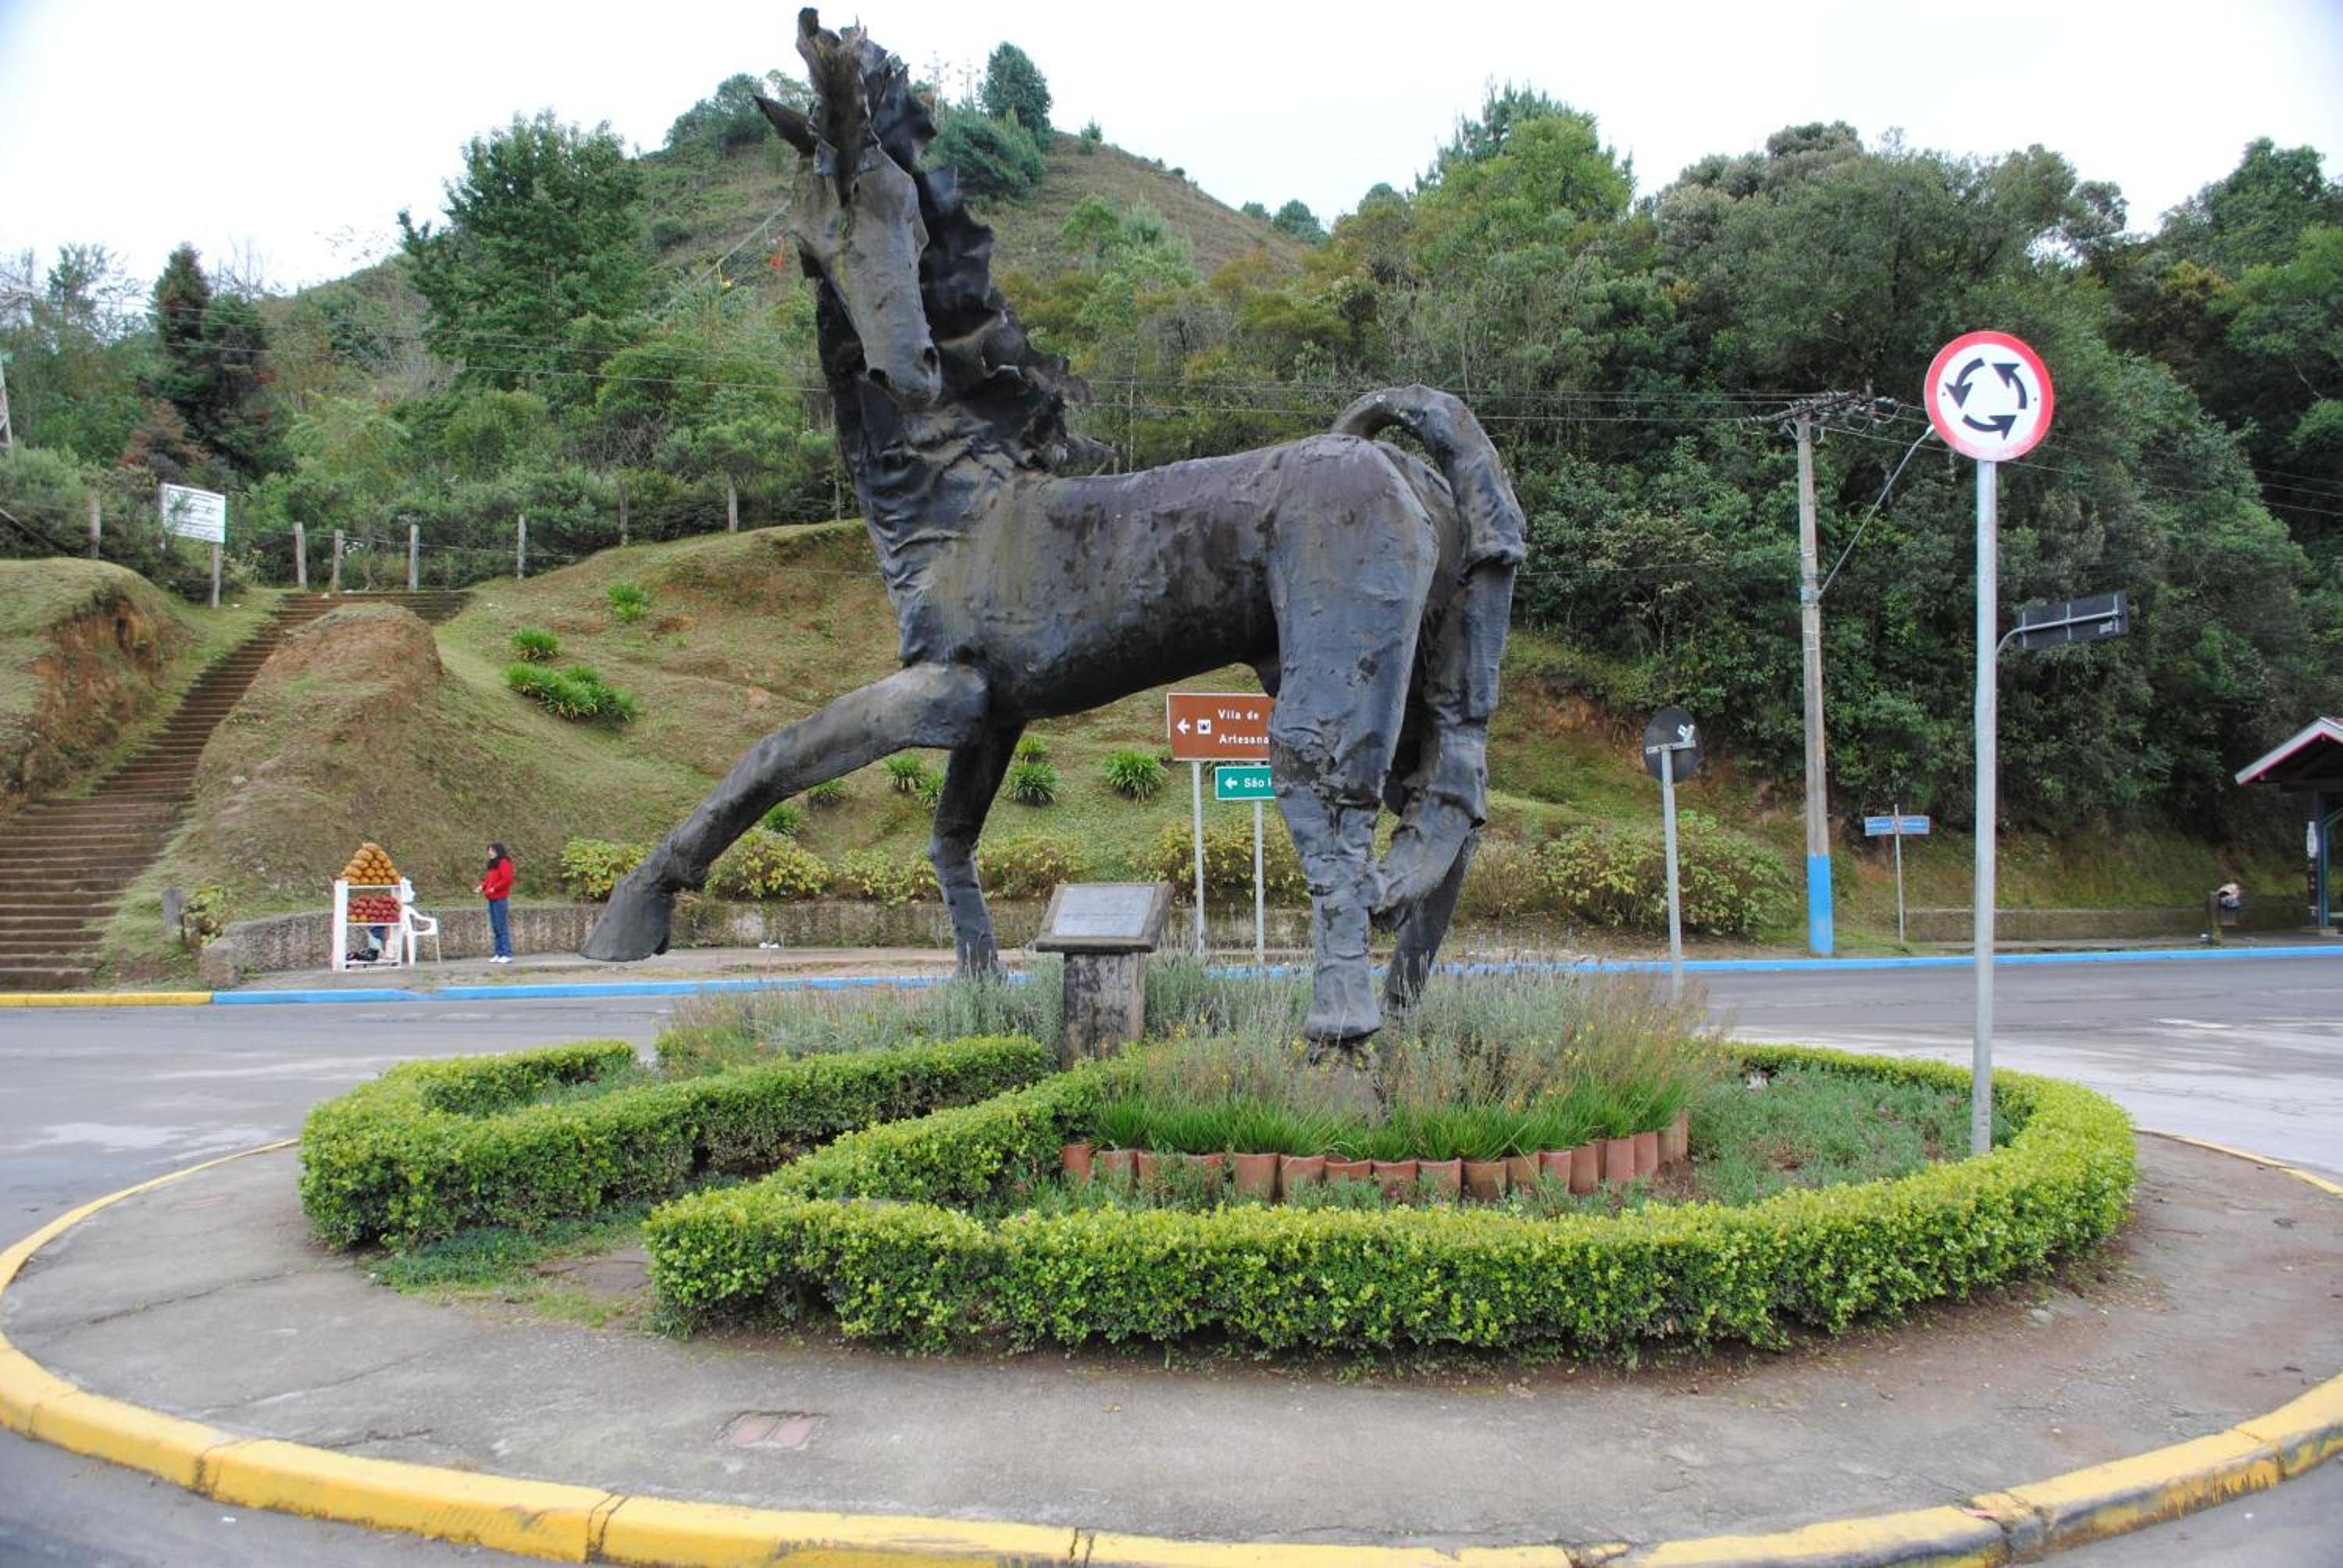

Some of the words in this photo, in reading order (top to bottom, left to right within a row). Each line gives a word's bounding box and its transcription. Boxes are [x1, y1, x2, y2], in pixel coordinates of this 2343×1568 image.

[1218, 709, 1241, 720] Vila
[1246, 710, 1260, 720] de
[1219, 733, 1270, 744] Artesana
[1244, 777, 1264, 788] São
